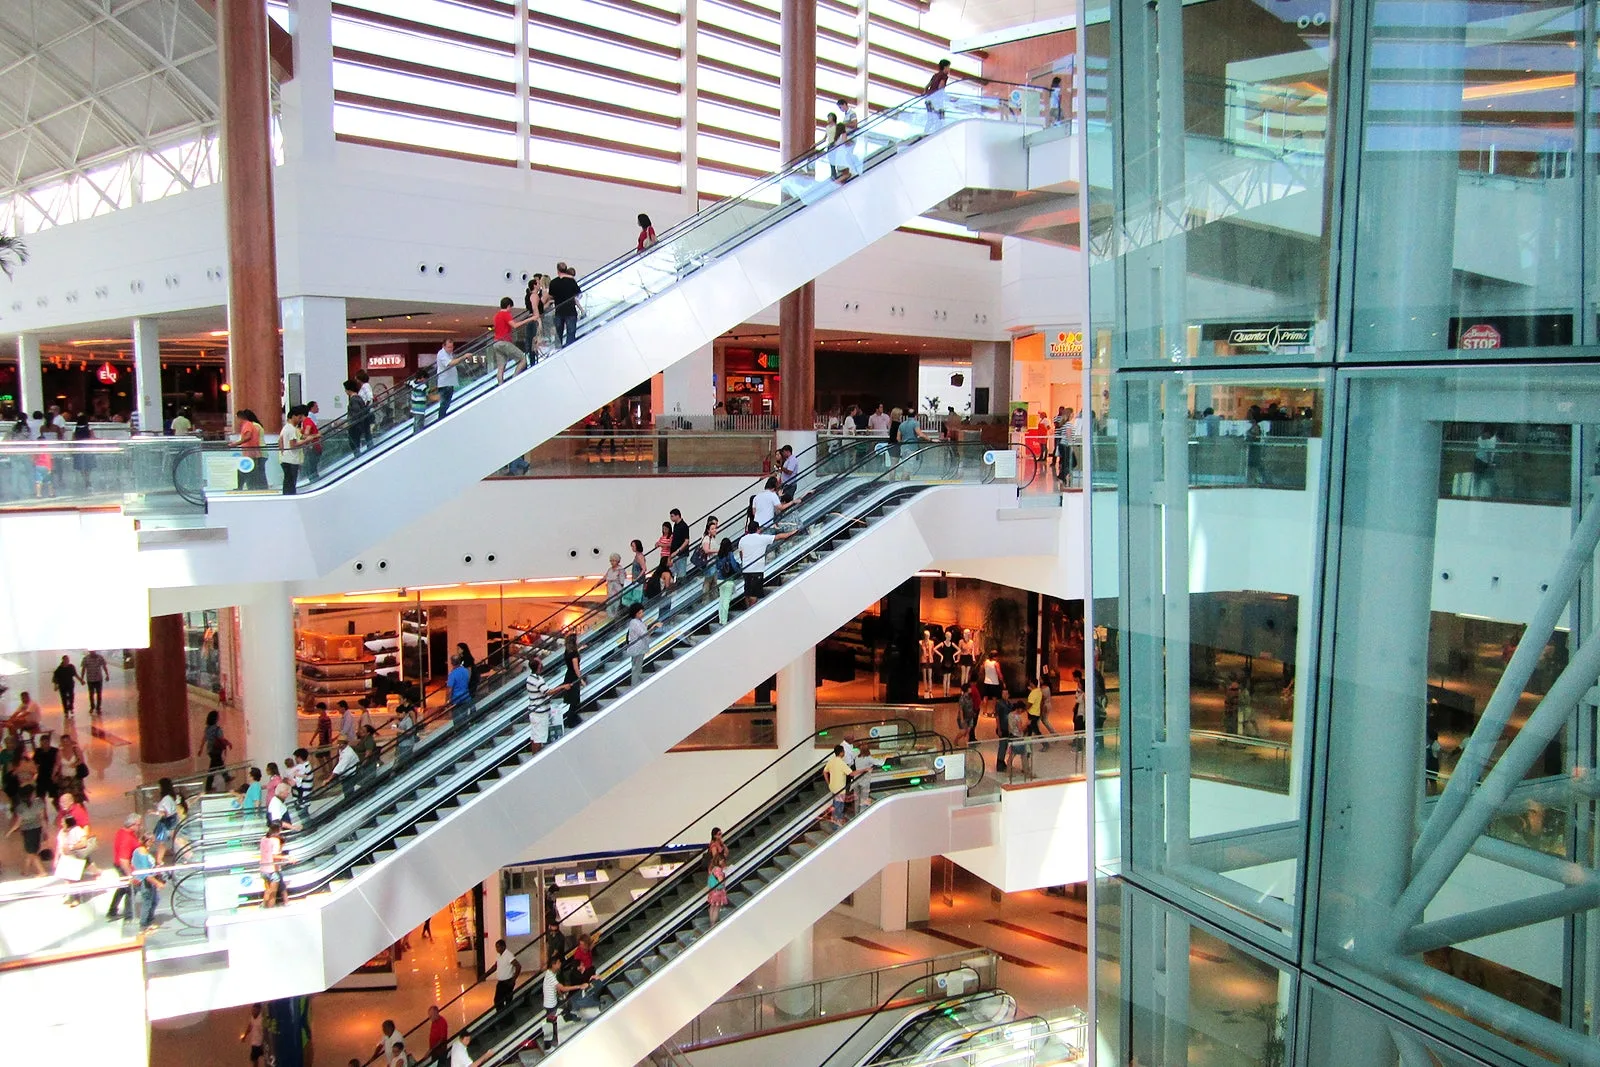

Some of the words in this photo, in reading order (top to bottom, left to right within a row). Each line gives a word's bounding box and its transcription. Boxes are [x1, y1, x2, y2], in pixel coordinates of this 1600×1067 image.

[1233, 332, 1267, 343] Quanto
[1281, 331, 1308, 341] Prima
[1463, 339, 1497, 350] STOP
[369, 356, 402, 366] SPOLETO
